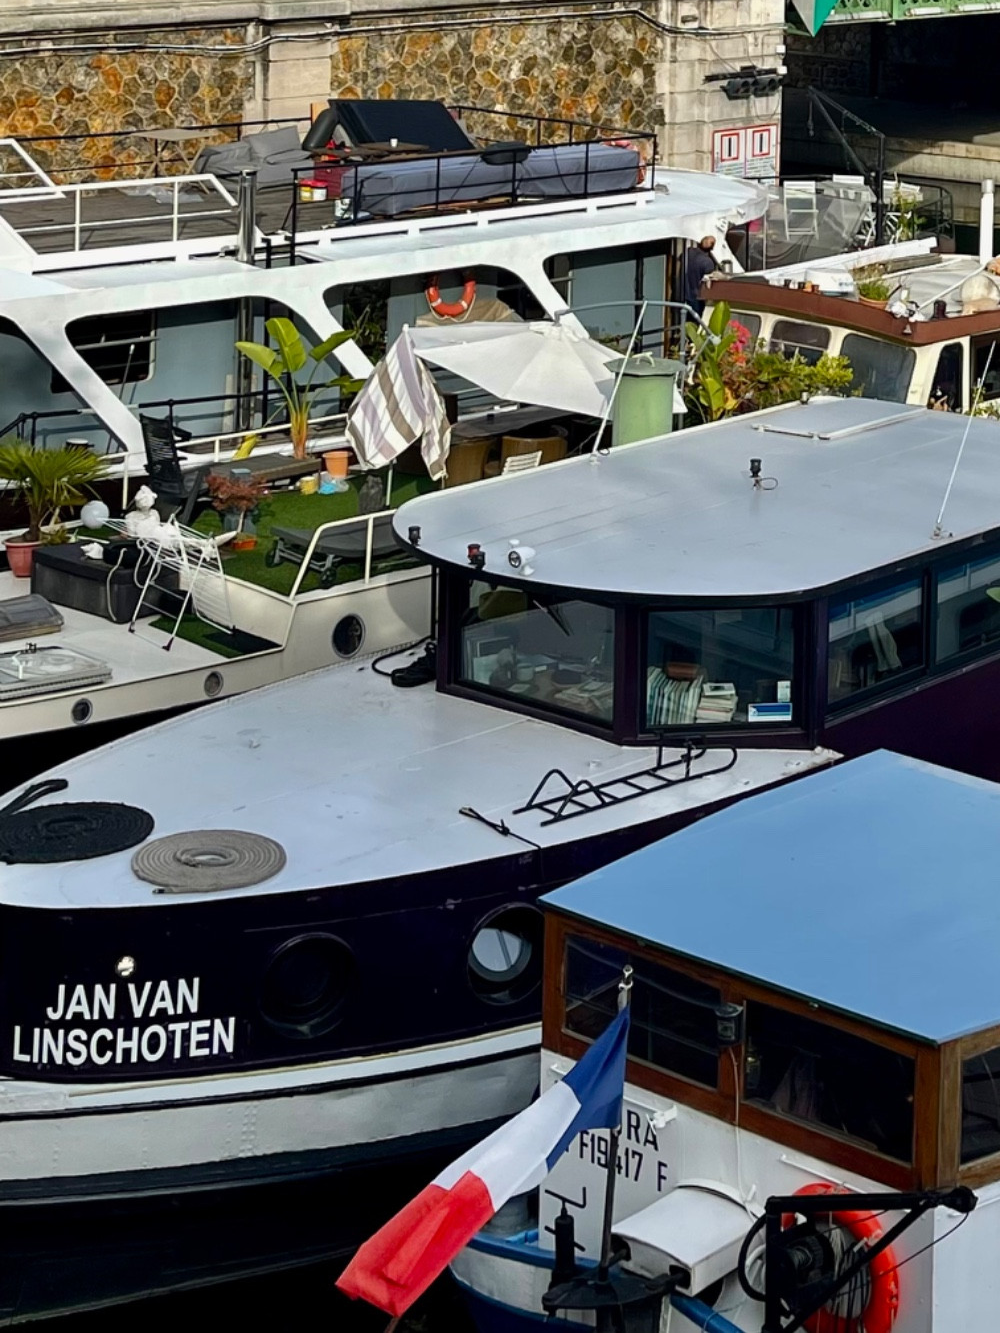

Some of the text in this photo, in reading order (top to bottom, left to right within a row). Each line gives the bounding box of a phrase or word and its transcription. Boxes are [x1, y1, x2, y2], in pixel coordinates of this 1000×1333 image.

[46, 977, 200, 1021] JAN VAN
[12, 1017, 236, 1066] LINSCHOTEN
